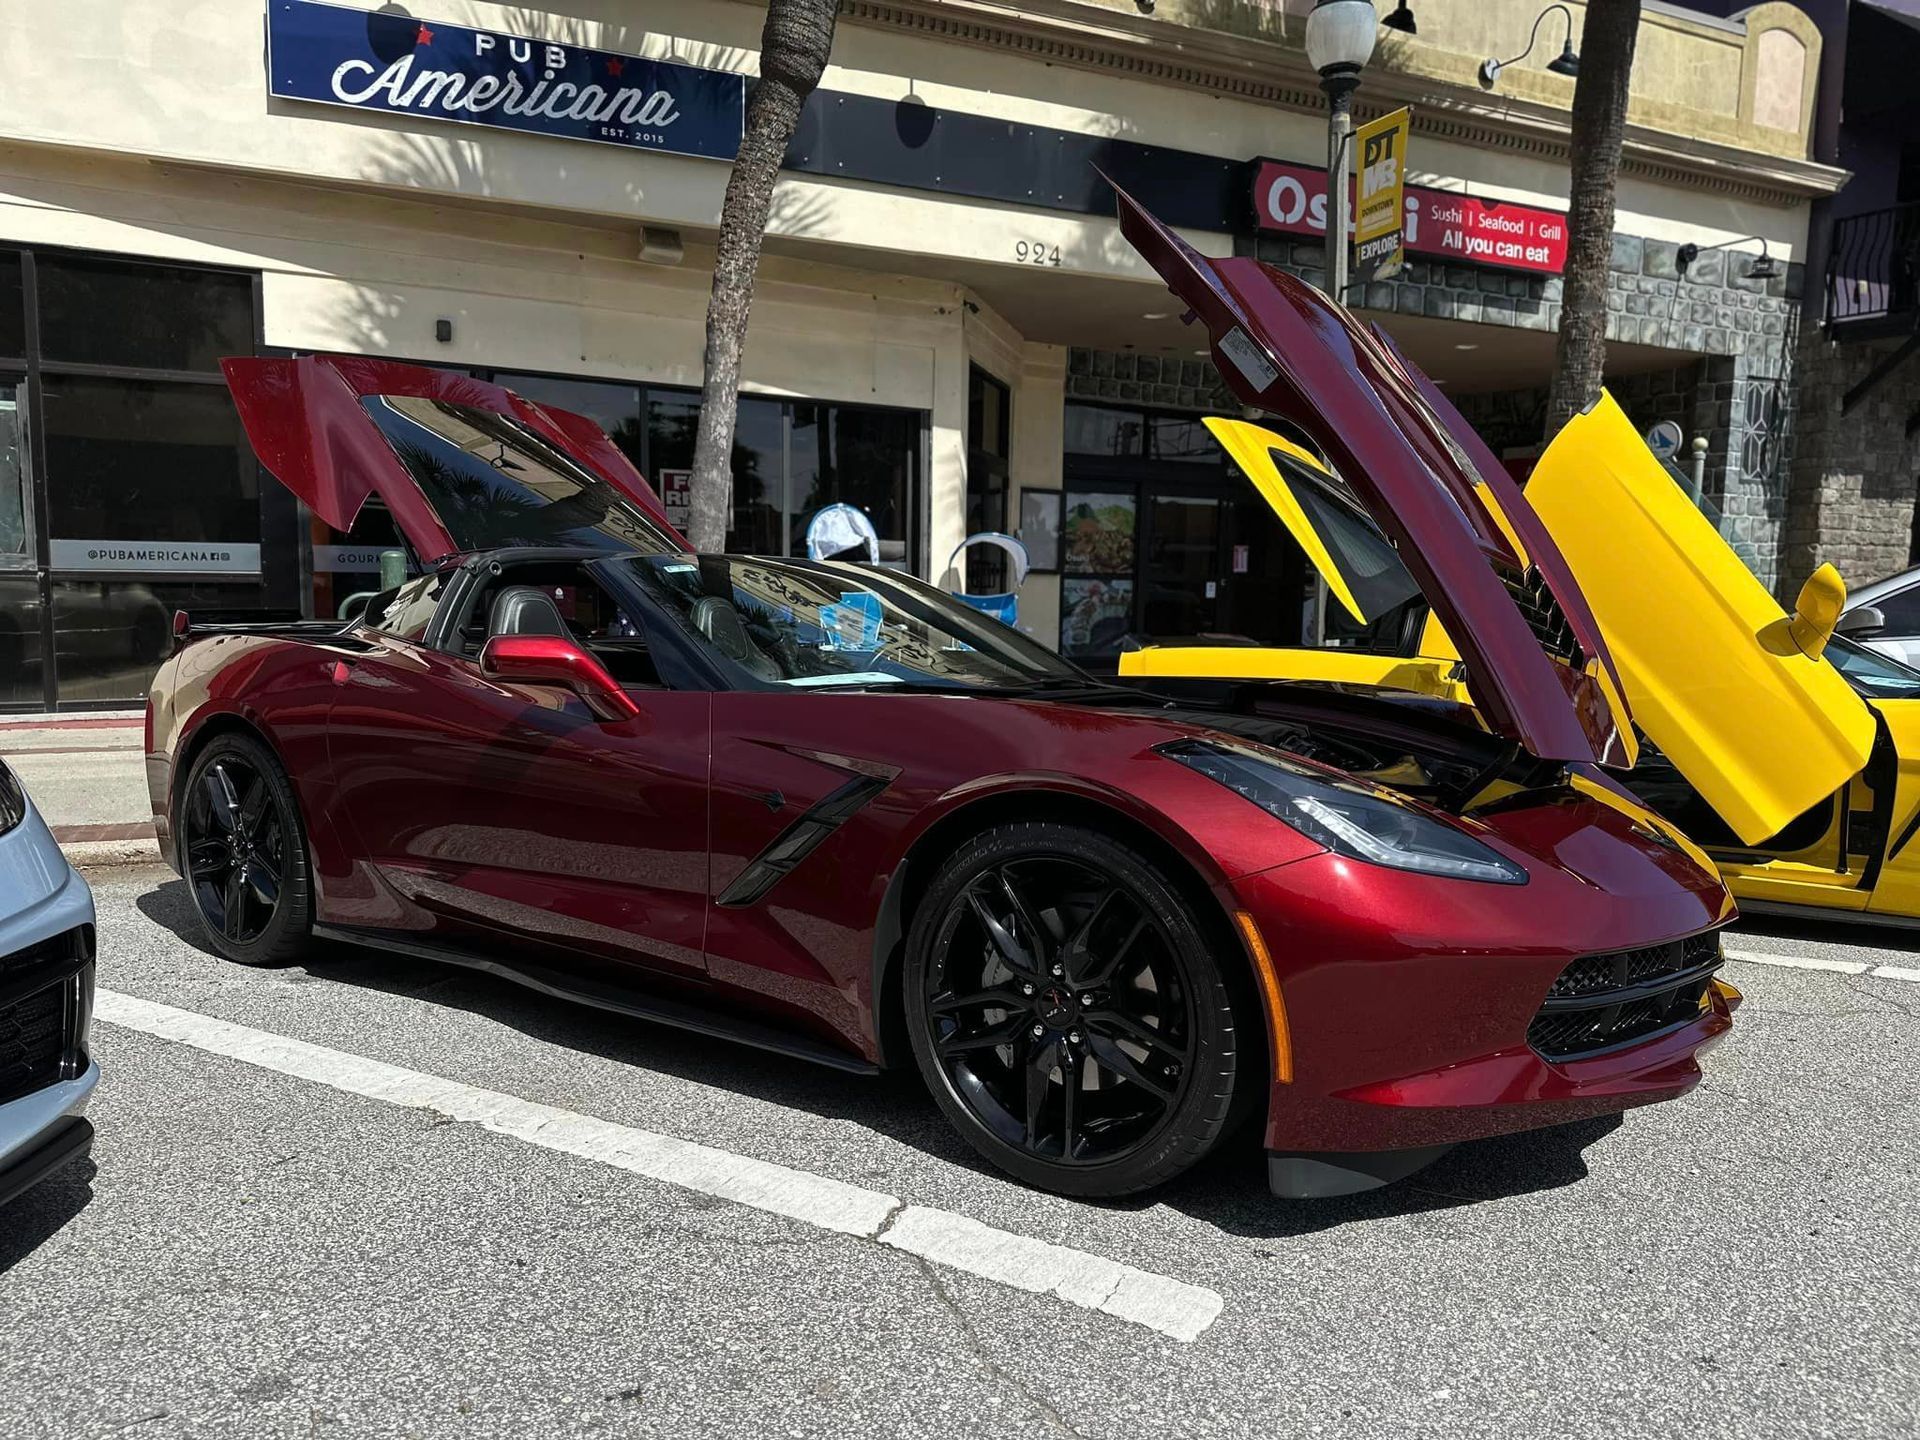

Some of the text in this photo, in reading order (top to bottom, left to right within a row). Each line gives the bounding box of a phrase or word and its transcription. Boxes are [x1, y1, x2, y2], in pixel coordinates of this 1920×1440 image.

[475, 33, 567, 69] PUB
[331, 53, 681, 127] Americana
[601, 127, 664, 144] EST. 2015
[1364, 126, 1400, 169] DT
[1361, 198, 1394, 218] DOWNTOWN
[1431, 205, 1463, 224] Sushi
[1478, 213, 1525, 235] Seafood
[1538, 224, 1562, 241] Grill
[1016, 240, 1062, 267] 924
[1360, 234, 1400, 262] EXPLORE
[1441, 229, 1550, 263] All you can eat
[87, 549, 209, 562] @PUBAMERICANA
